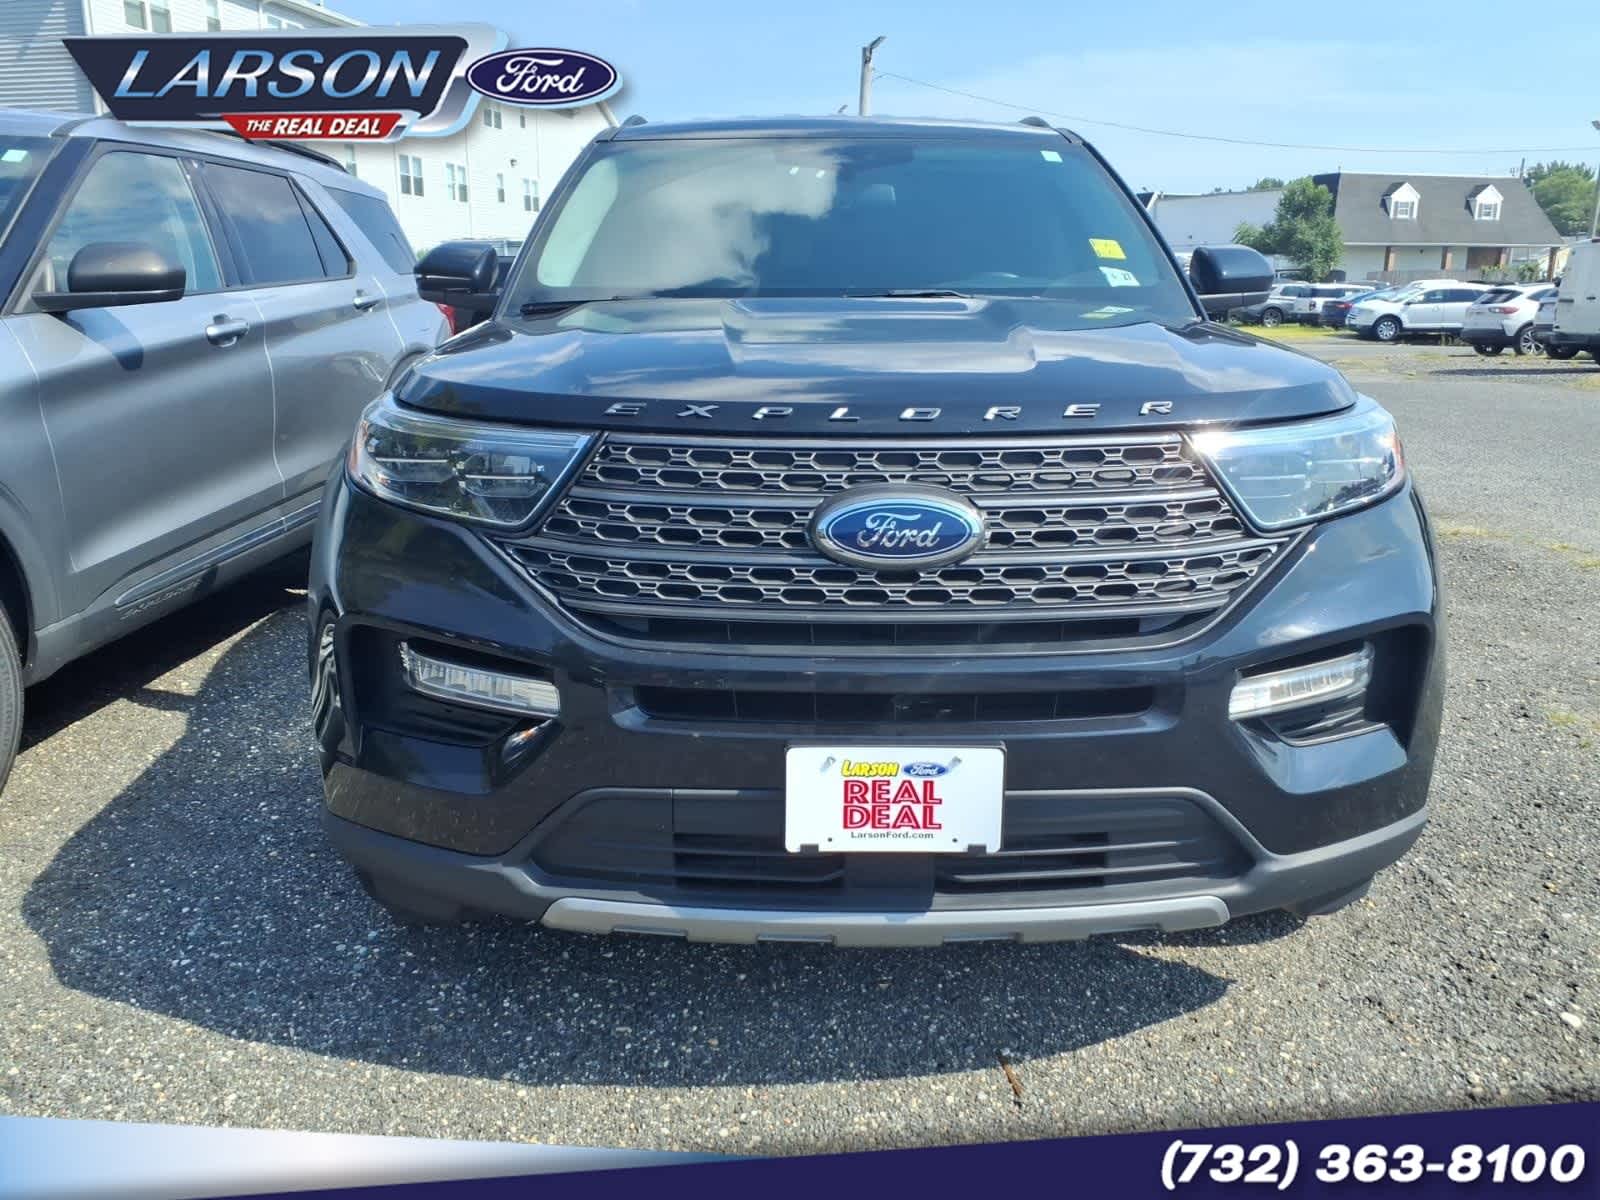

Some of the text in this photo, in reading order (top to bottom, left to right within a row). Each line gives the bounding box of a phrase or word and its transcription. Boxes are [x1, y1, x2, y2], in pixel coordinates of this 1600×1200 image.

[604, 401, 1173, 423] EXPLORER
[856, 512, 943, 548] Ford
[841, 759, 940, 777] LARSON Ford
[843, 780, 942, 804] REAL
[843, 805, 942, 829] DEAL
[850, 831, 934, 840] LarsonFord.com
